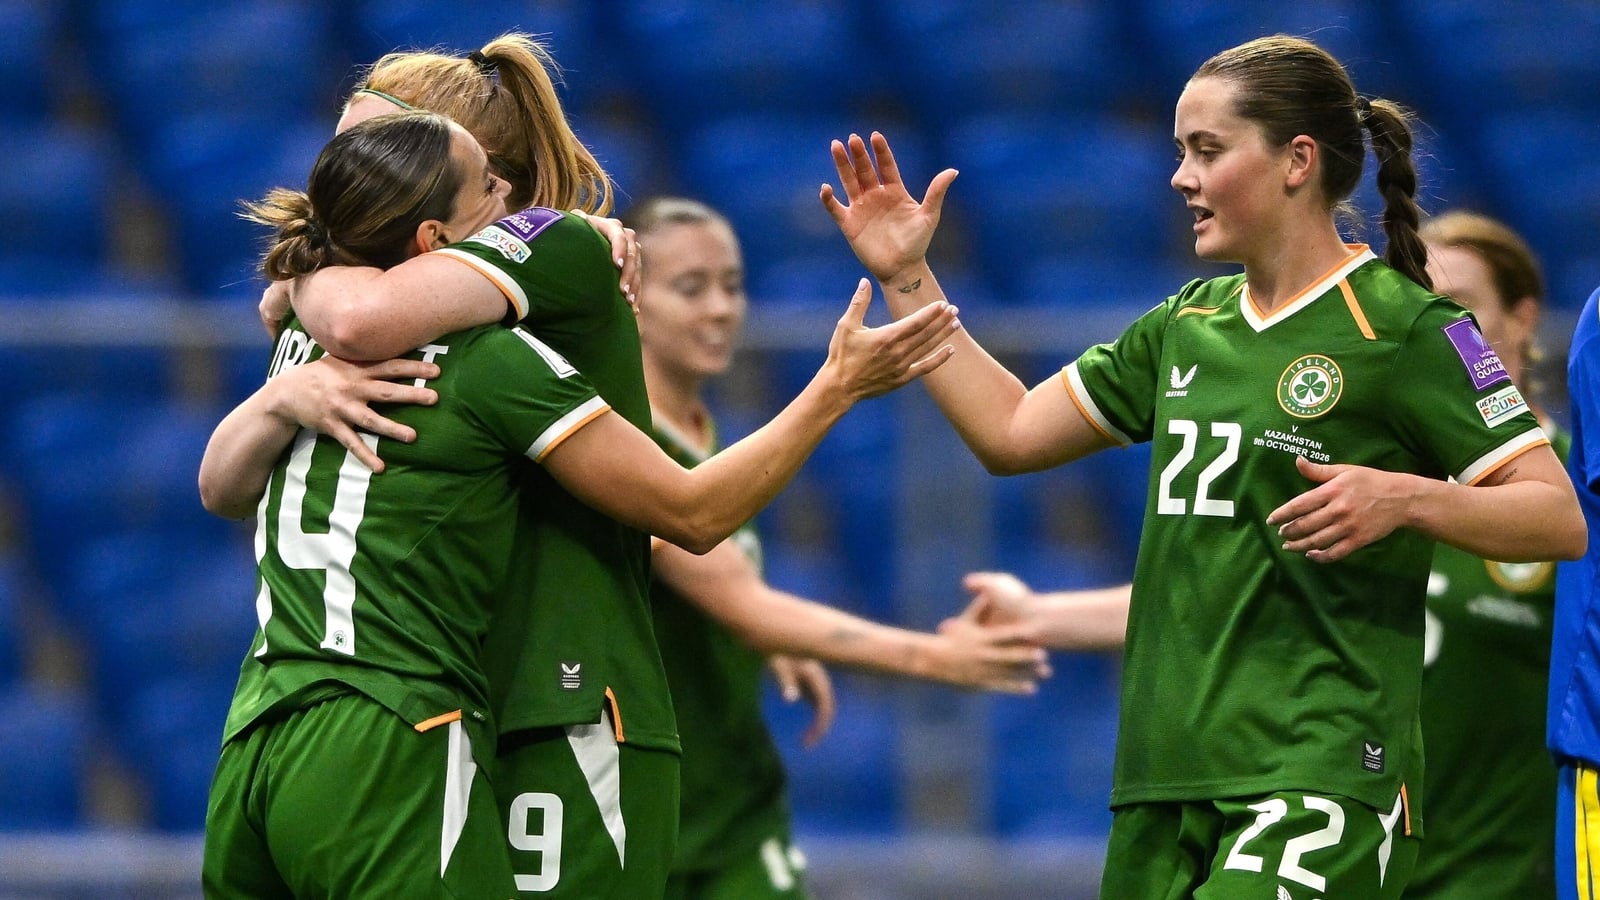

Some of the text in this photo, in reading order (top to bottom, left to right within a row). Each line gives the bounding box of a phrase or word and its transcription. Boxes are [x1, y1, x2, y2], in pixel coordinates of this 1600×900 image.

[1290, 358, 1340, 384] IRELAND
[1479, 396, 1497, 408] UEFA
[1264, 429, 1323, 450] KAZAKHSTAN
[1291, 424, 1299, 433] V
[1265, 439, 1309, 457] OCTOBER
[1309, 450, 1331, 462] 2026
[1157, 419, 1242, 517] 22
[508, 792, 563, 892] 9
[1223, 795, 1346, 893] 22
